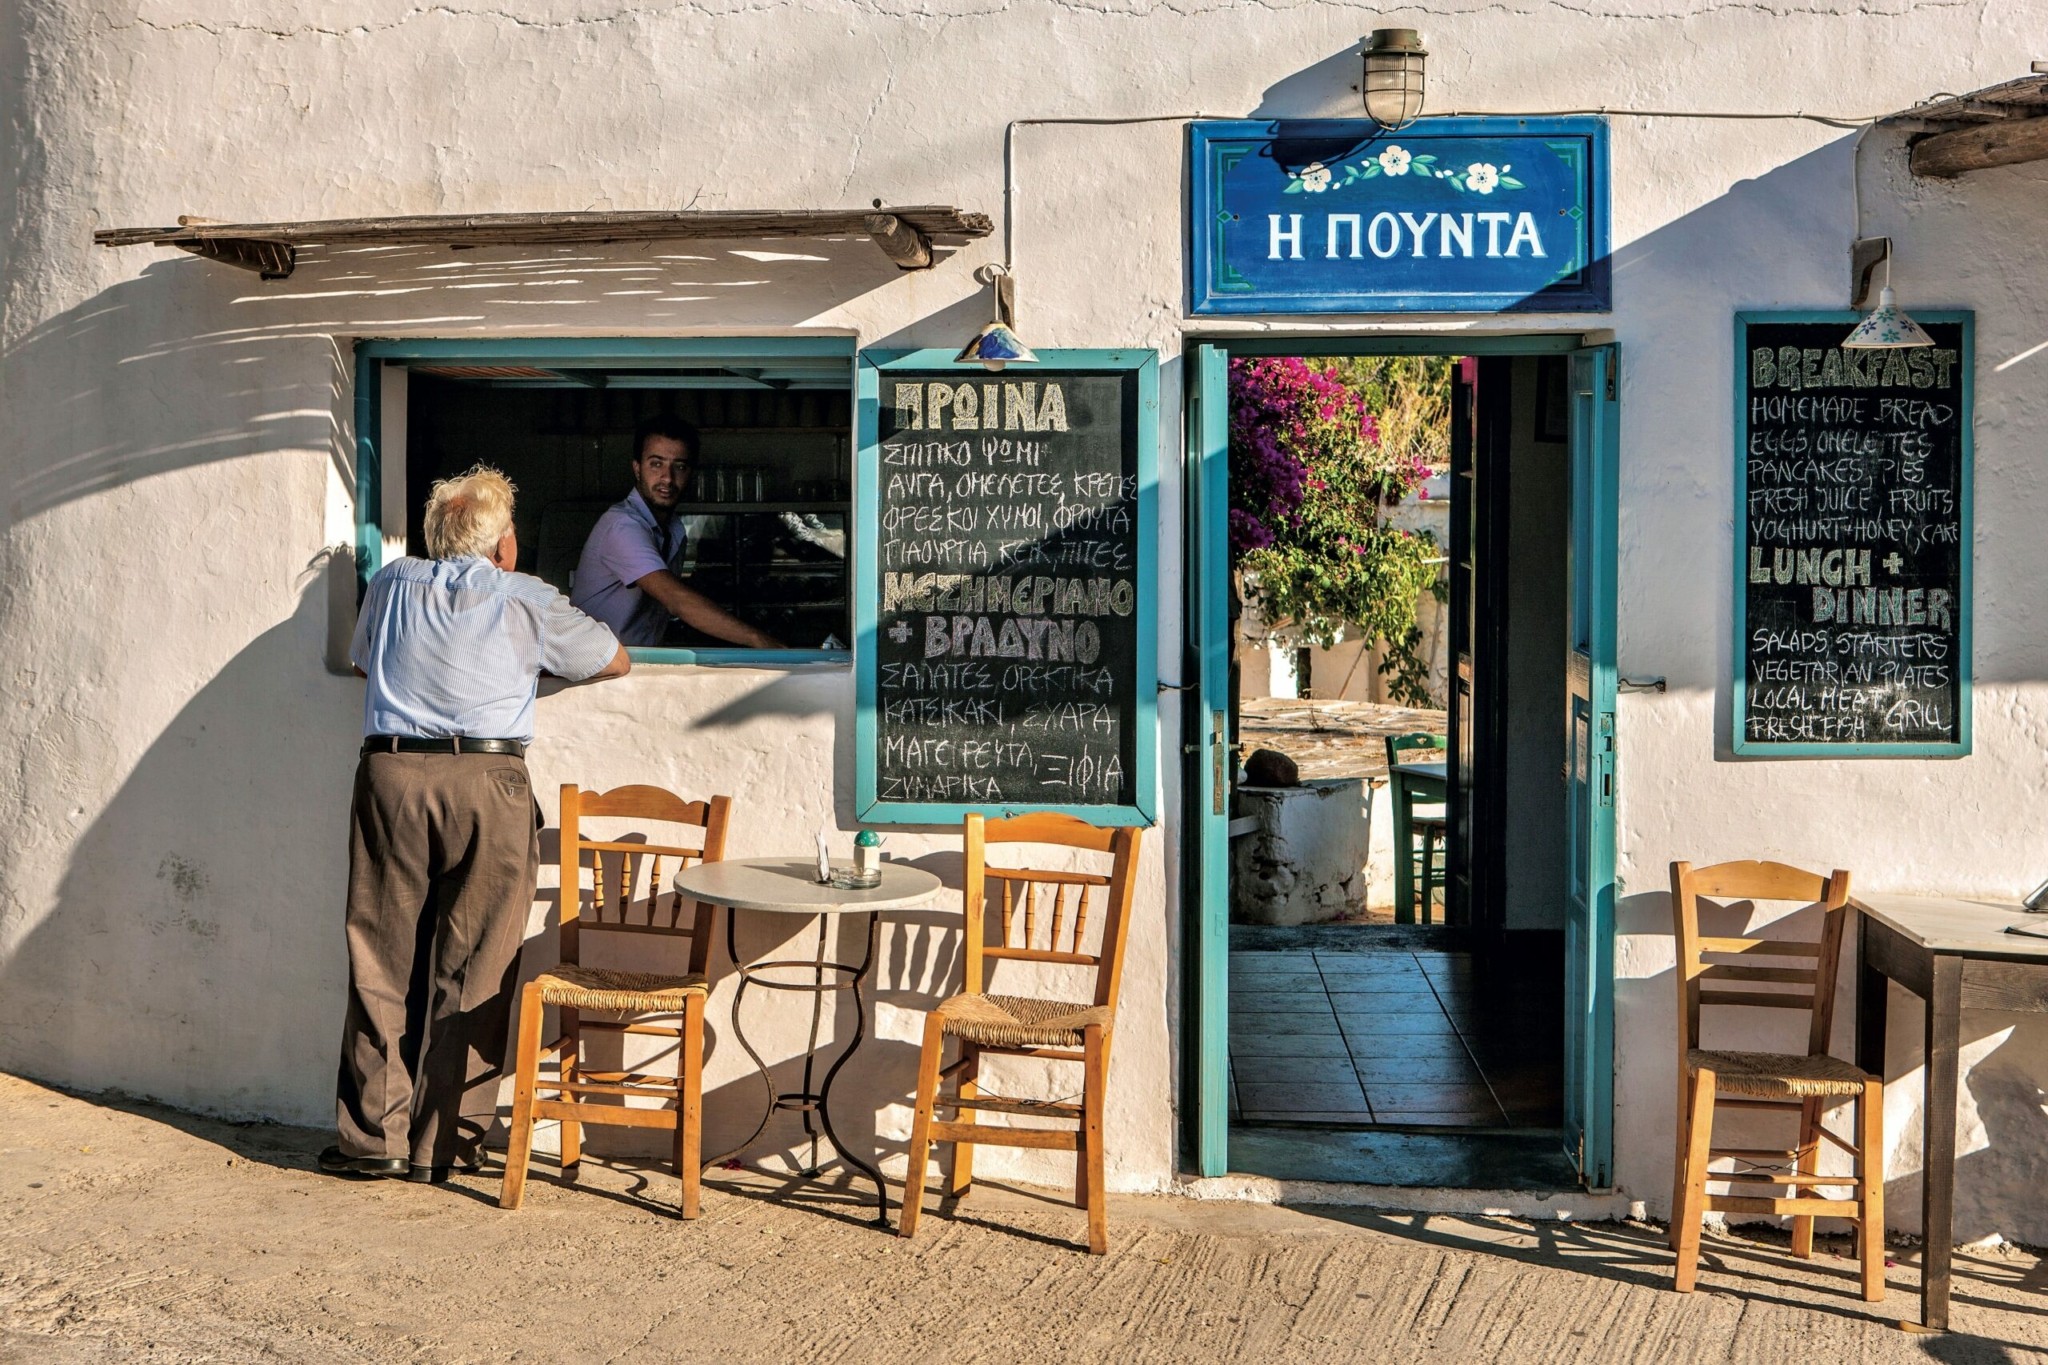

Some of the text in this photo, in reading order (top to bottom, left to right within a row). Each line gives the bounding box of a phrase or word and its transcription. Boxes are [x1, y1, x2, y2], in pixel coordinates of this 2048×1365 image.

[1267, 211, 1548, 260] Η ΠΟΥΝΤΑ
[1752, 347, 1957, 391] BREAKFAST
[895, 383, 1069, 431] ΠΡΩΙΝΑ
[1752, 396, 1953, 428] HOMEMADE BREAD
[982, 436, 1040, 466] ΨΩΜΙ
[1750, 429, 1811, 459] EGGS,
[1748, 459, 1925, 487] PANCAKES, PIES
[1749, 489, 1808, 516] FRESH
[1061, 541, 1132, 571] ΠΙΤΕΣ
[1750, 547, 1871, 587] LUNCH
[884, 572, 1133, 616] ΜΕΣΗΜΕΡΙΑΝΟ
[1812, 587, 1951, 633] DINNER
[925, 616, 1101, 664] ΒΡΑΔΥΝΟ
[1753, 628, 1948, 659] SALADS, STARTERS
[1003, 665, 1114, 695] ΟΡΕΚΤΙΚΑ
[1753, 659, 1949, 689] VEGETARIAN PLATES
[1751, 686, 1812, 709] LOCAL
[1746, 715, 1865, 740] FRESH FISH
[1886, 699, 1953, 733] GRILL
[1041, 744, 1124, 795] ΞΙΦΙΑ
[883, 774, 1003, 800] ΖΥΜΑΡΙΚΑ
